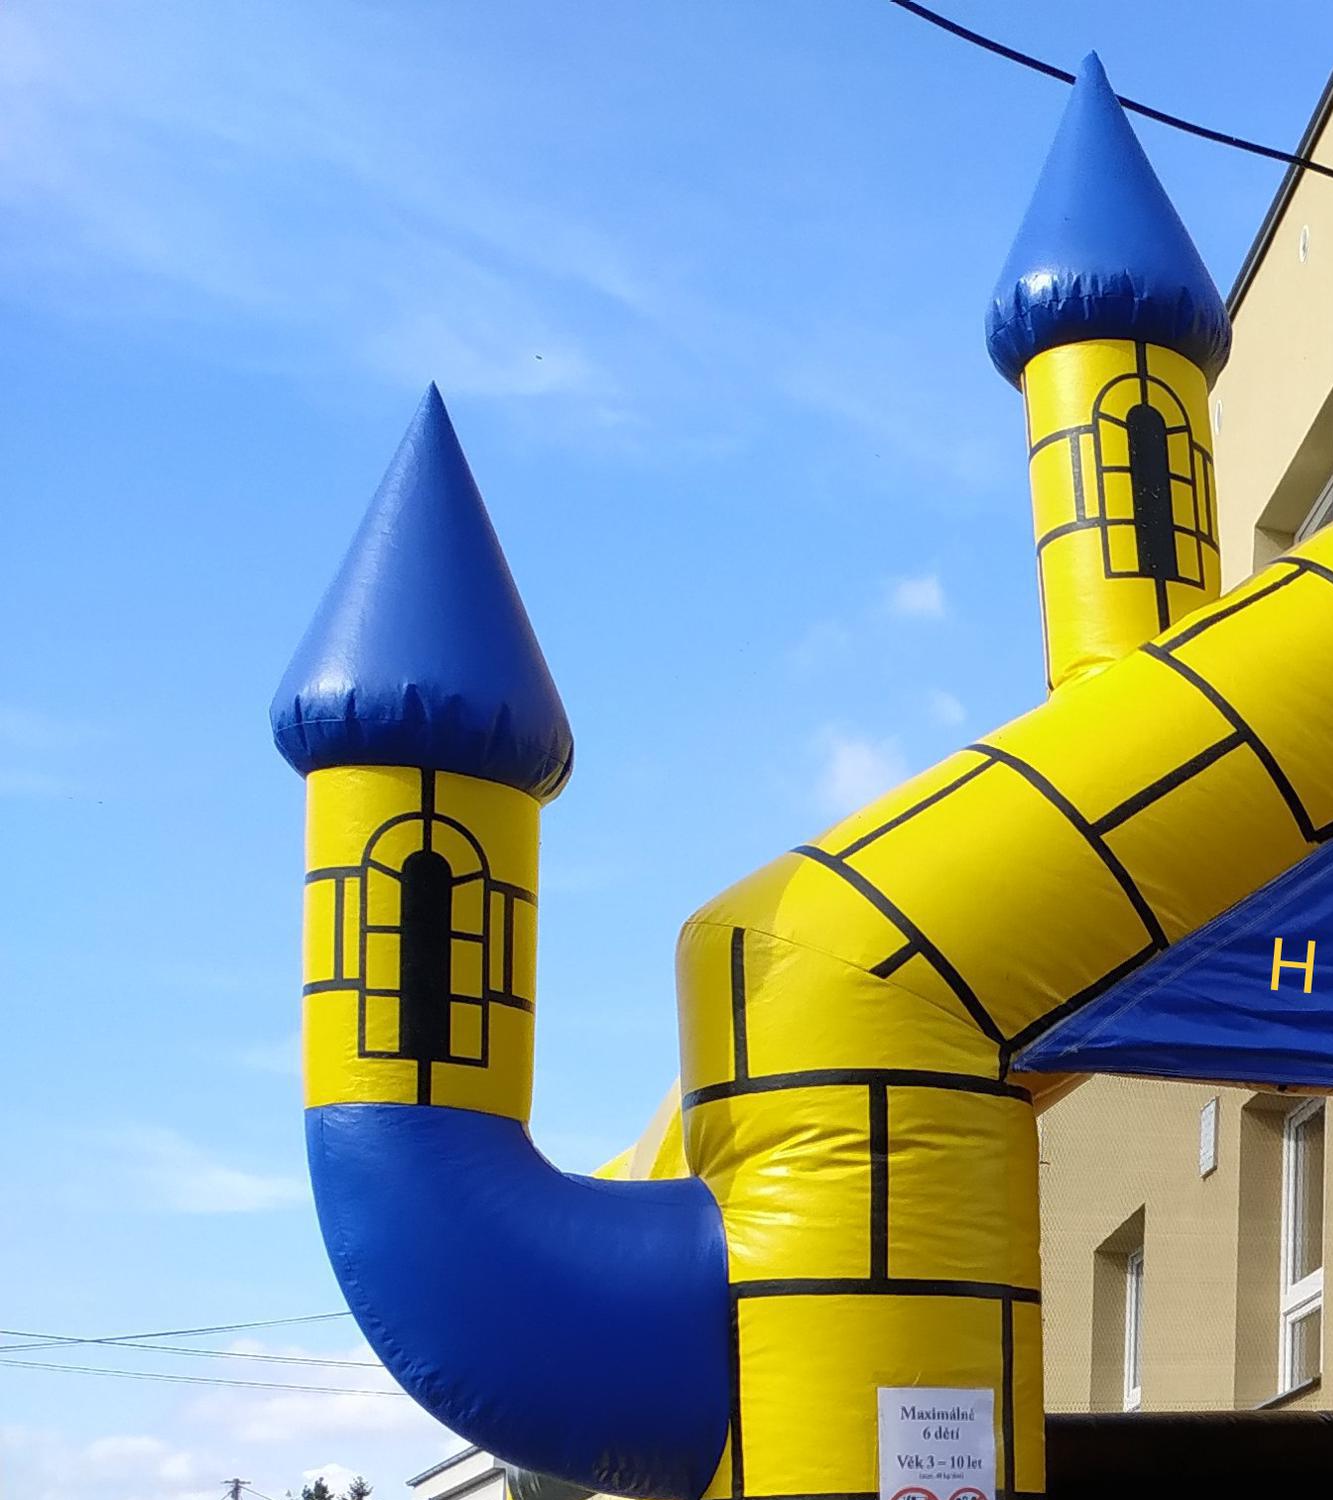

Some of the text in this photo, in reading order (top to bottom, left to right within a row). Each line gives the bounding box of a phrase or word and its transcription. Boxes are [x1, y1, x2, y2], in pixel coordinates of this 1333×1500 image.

[922, 1426, 931, 1440] 6
[897, 1454, 923, 1469] Věk
[927, 1455, 935, 1469] 3
[950, 1455, 964, 1469] 10
[967, 1455, 982, 1469] let
